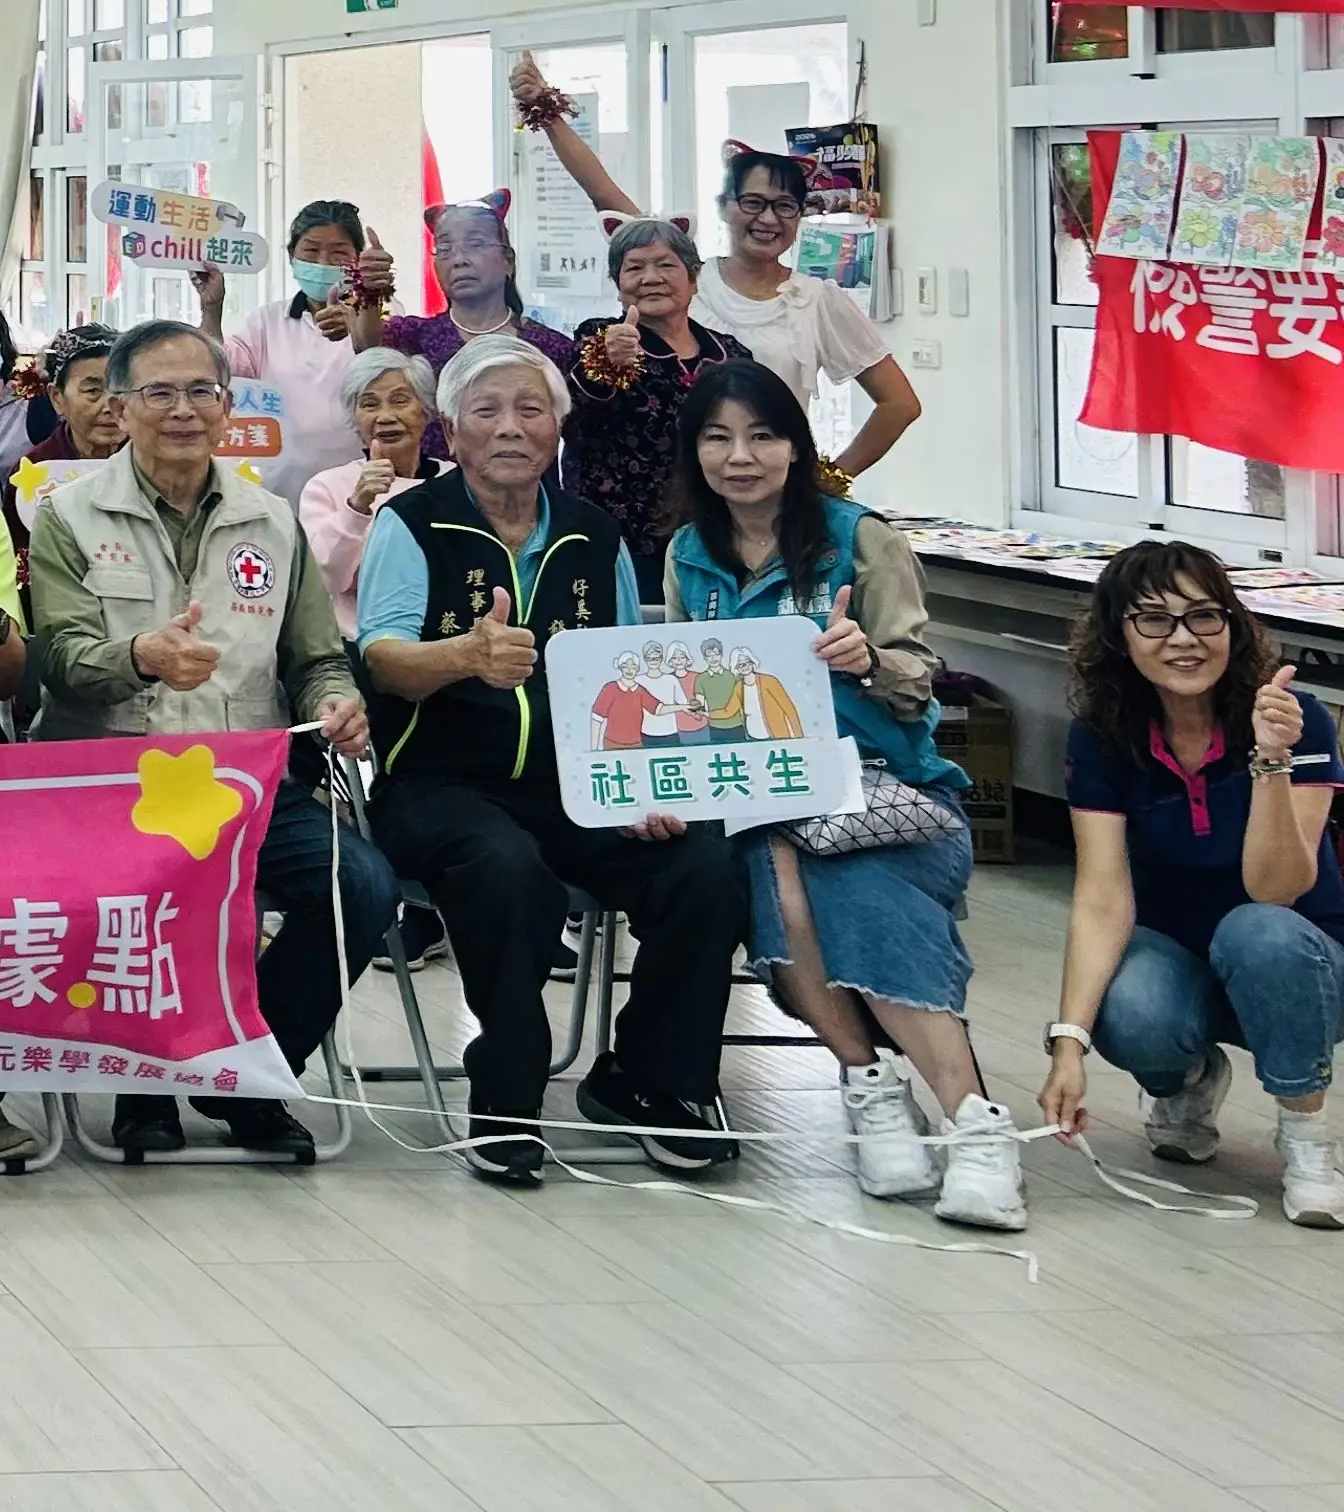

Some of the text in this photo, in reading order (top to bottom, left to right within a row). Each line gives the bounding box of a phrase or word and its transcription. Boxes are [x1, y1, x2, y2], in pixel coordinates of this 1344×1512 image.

[108, 190, 211, 232] 運動生活
[232, 388, 281, 413] 人生
[217, 424, 270, 448] 方箋
[572, 578, 592, 630] 好美
[438, 611, 461, 635] 蔡
[590, 748, 811, 806] 社區共生
